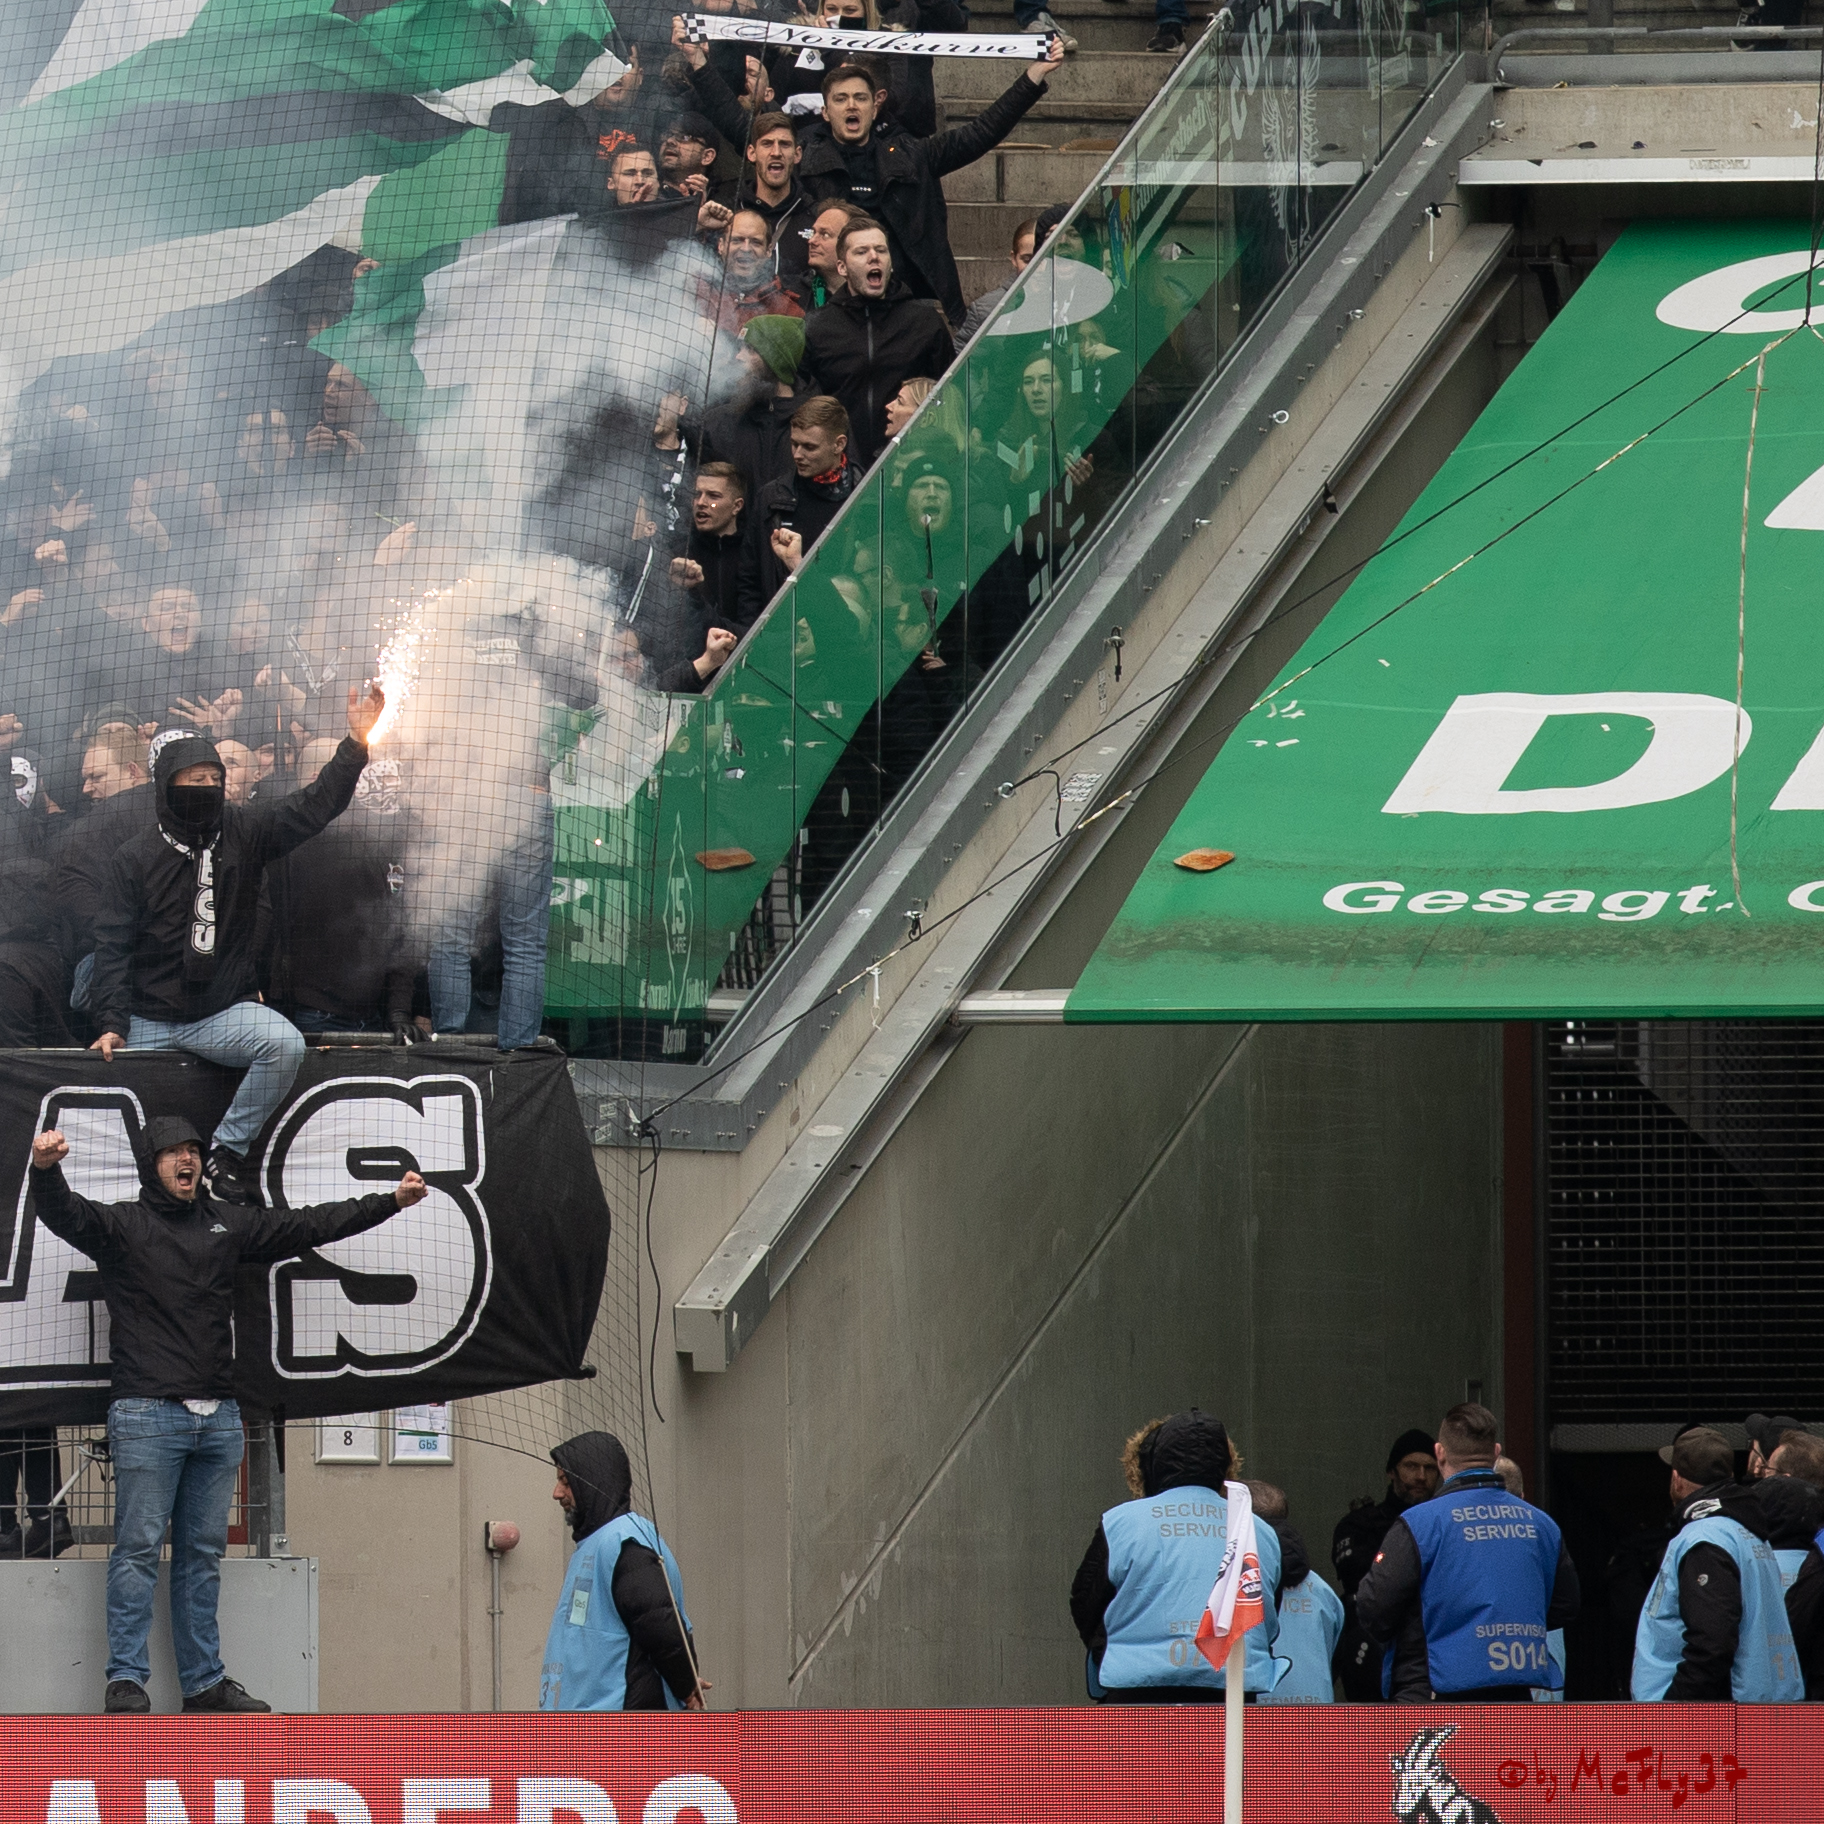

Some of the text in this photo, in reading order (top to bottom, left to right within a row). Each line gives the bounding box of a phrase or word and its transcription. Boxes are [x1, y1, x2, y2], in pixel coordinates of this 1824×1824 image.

[1321, 880, 1736, 923] Gesagt.
[343, 1429, 353, 1447] 8
[1151, 1501, 1228, 1521] SECURIT
[1450, 1504, 1534, 1524] SECURITY
[1159, 1521, 1228, 1540] SERVIC
[1462, 1522, 1539, 1543] SERVICE
[1475, 1622, 1547, 1640] SUPERVISO
[1487, 1640, 1549, 1673] S014
